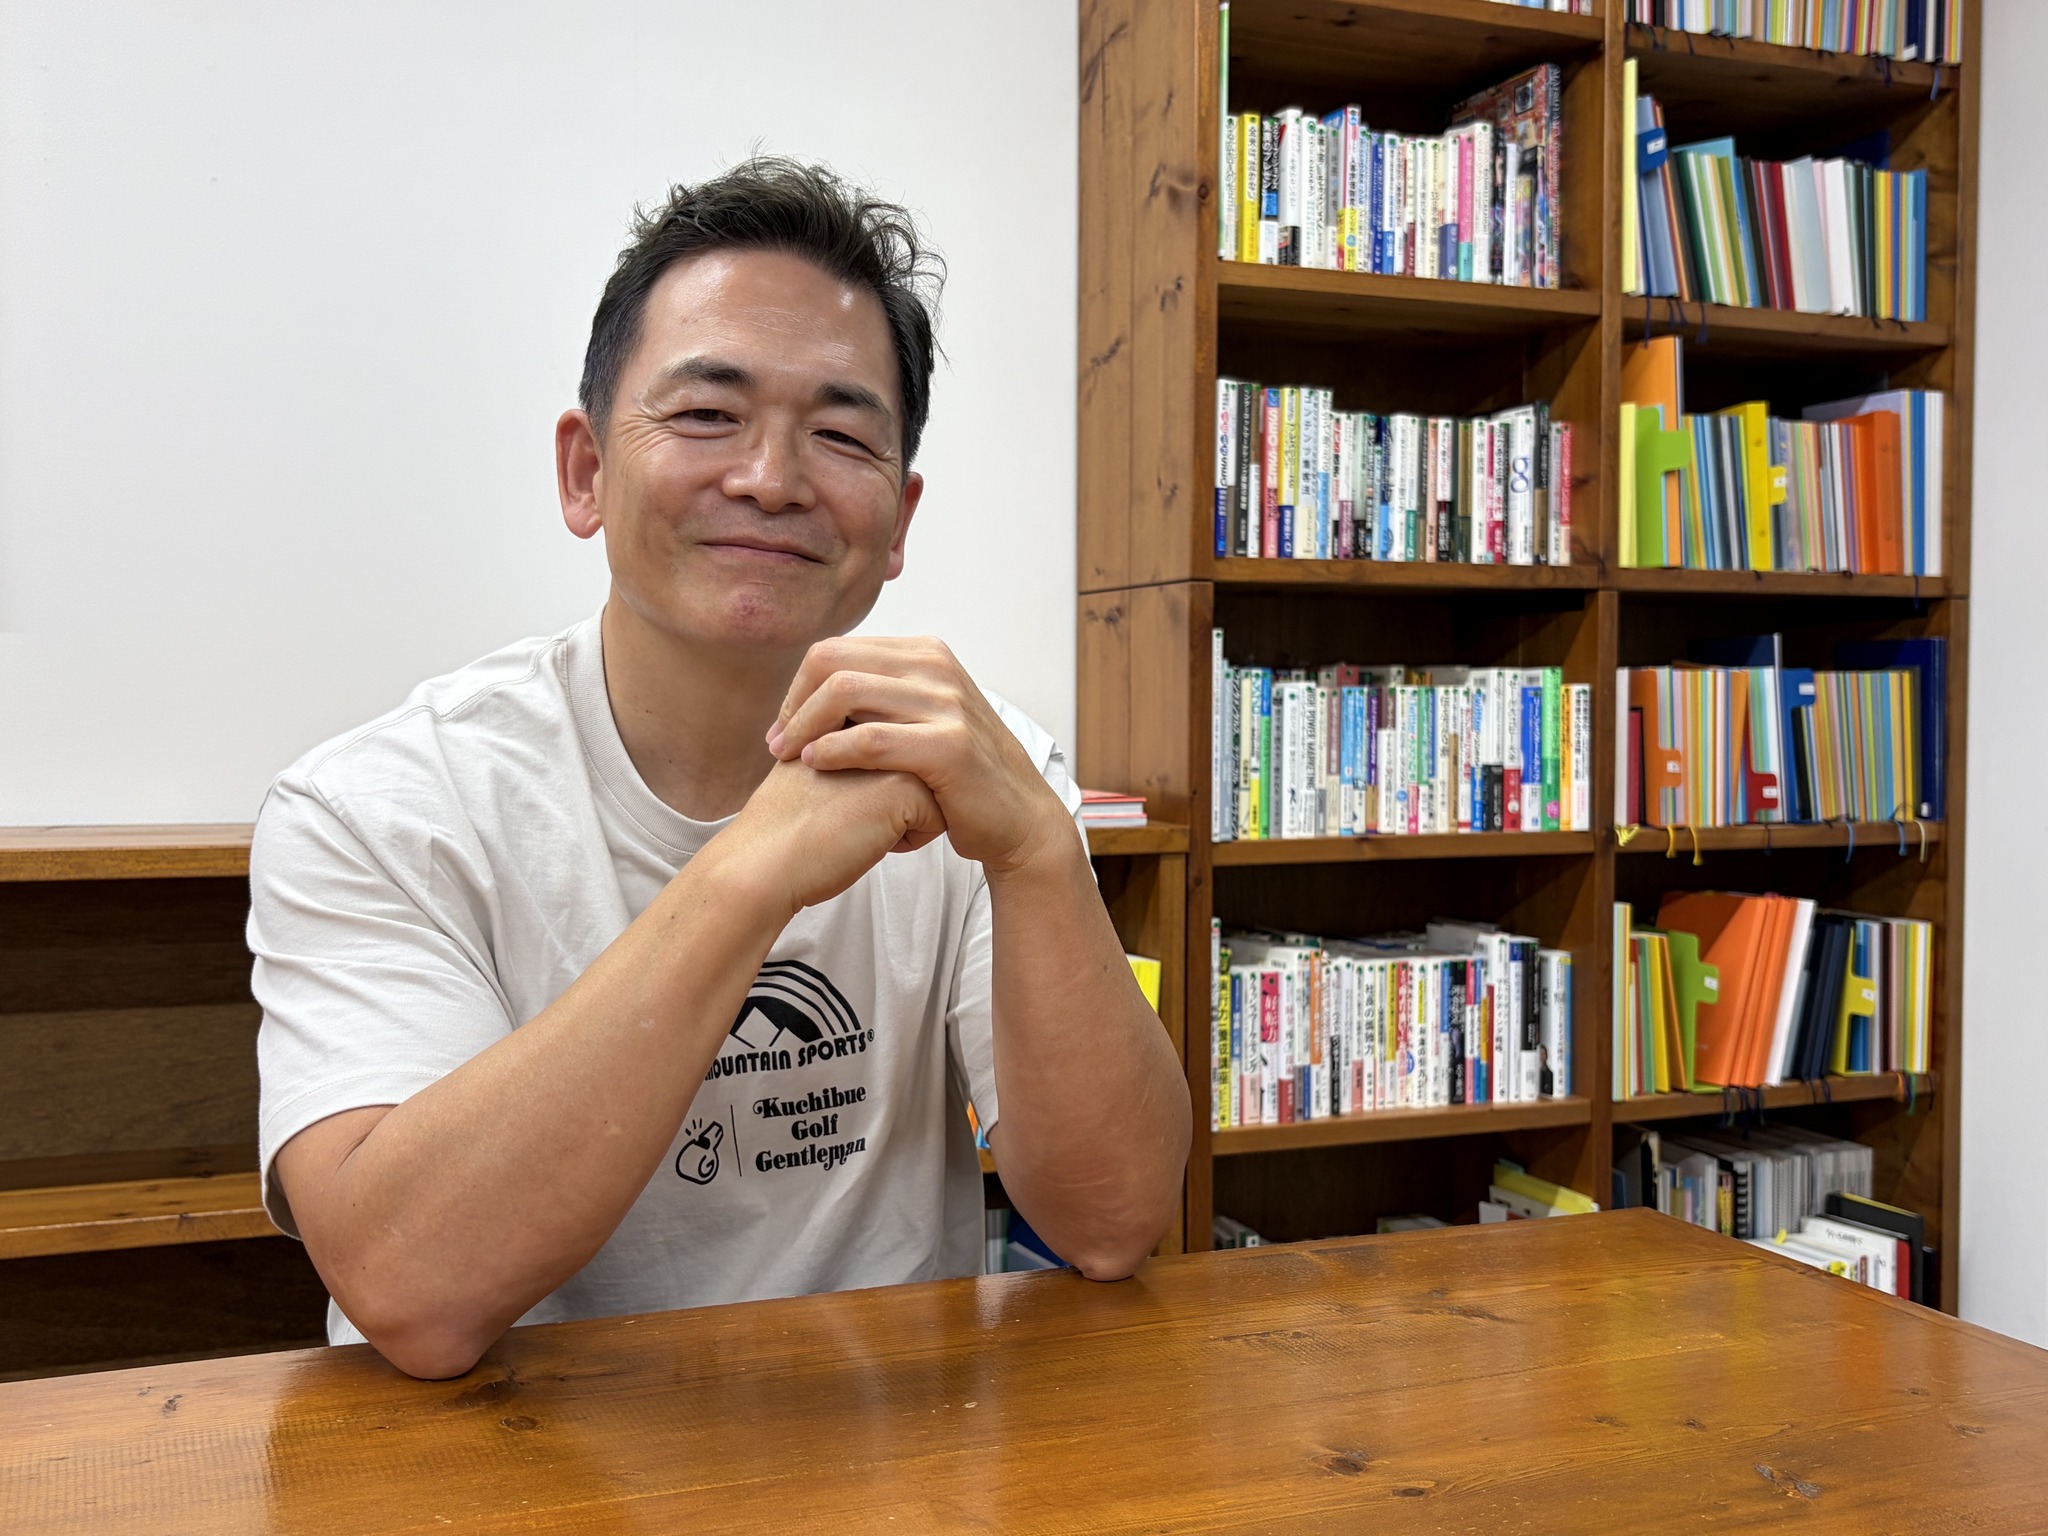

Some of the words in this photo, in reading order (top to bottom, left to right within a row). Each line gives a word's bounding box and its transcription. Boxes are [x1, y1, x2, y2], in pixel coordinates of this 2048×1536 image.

[1306, 711, 1316, 738] POWER
[1305, 743, 1316, 790] MARKETING
[753, 1086, 867, 1119] Kuchibue
[791, 1113, 839, 1141] Golf
[755, 1137, 867, 1172] Gentleman
